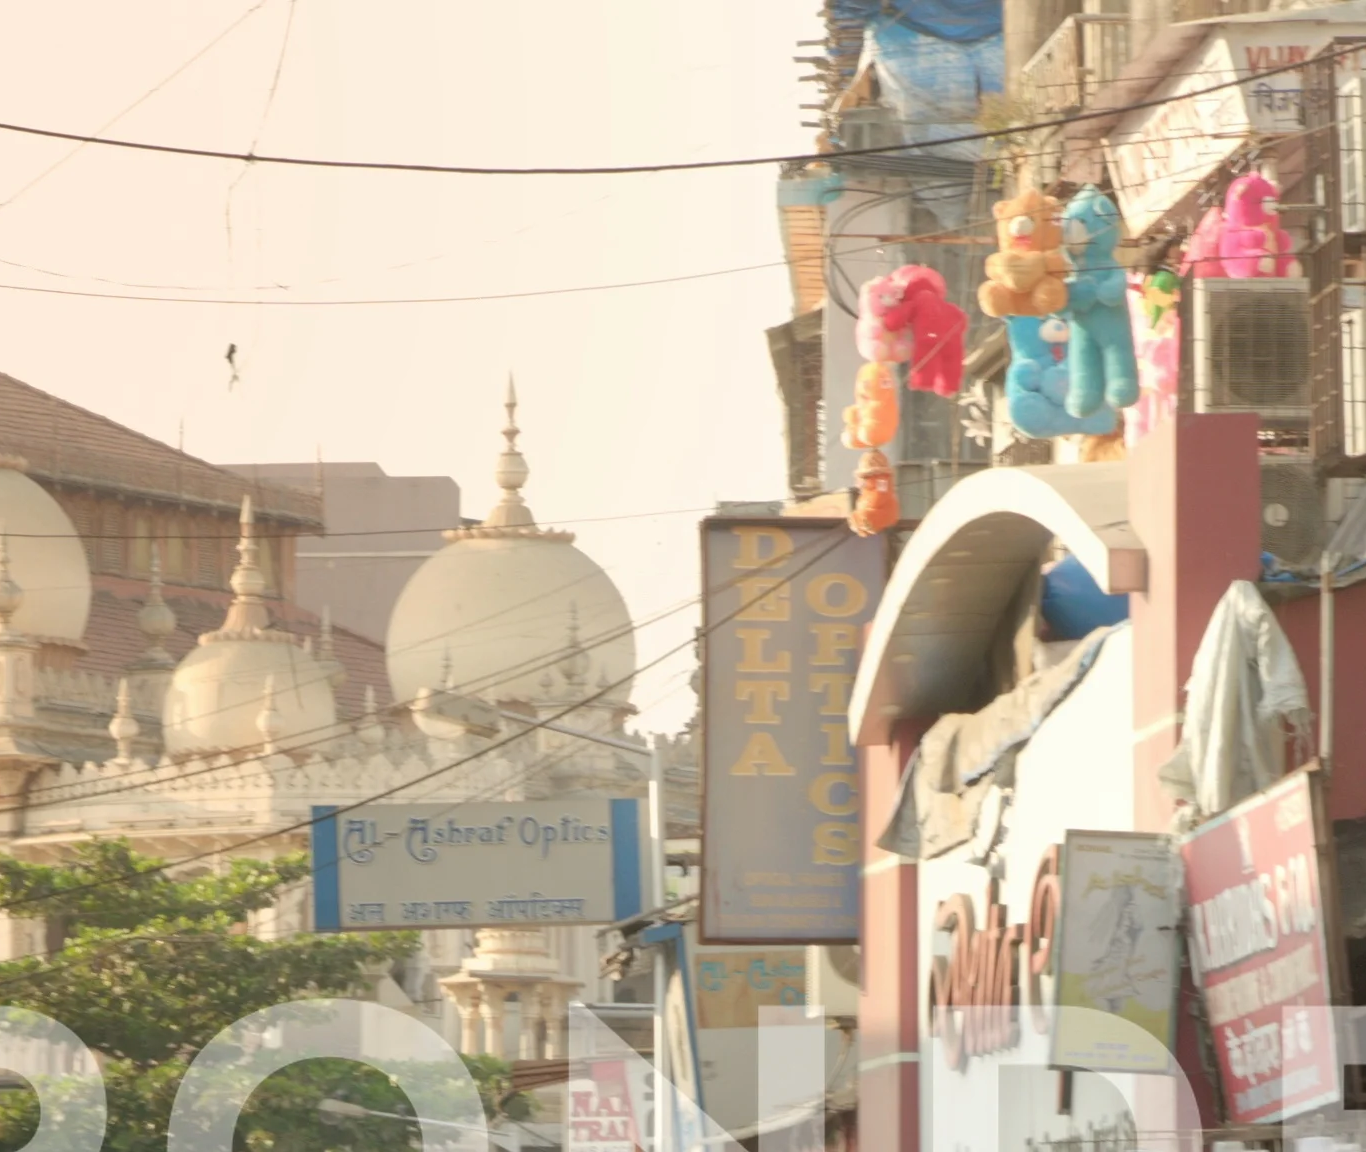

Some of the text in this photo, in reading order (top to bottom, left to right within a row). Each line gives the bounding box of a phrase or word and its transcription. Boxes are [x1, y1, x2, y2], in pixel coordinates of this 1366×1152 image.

[729, 526, 797, 777] DELTA
[806, 572, 869, 867] OPTICS
[517, 814, 612, 860] Optics
